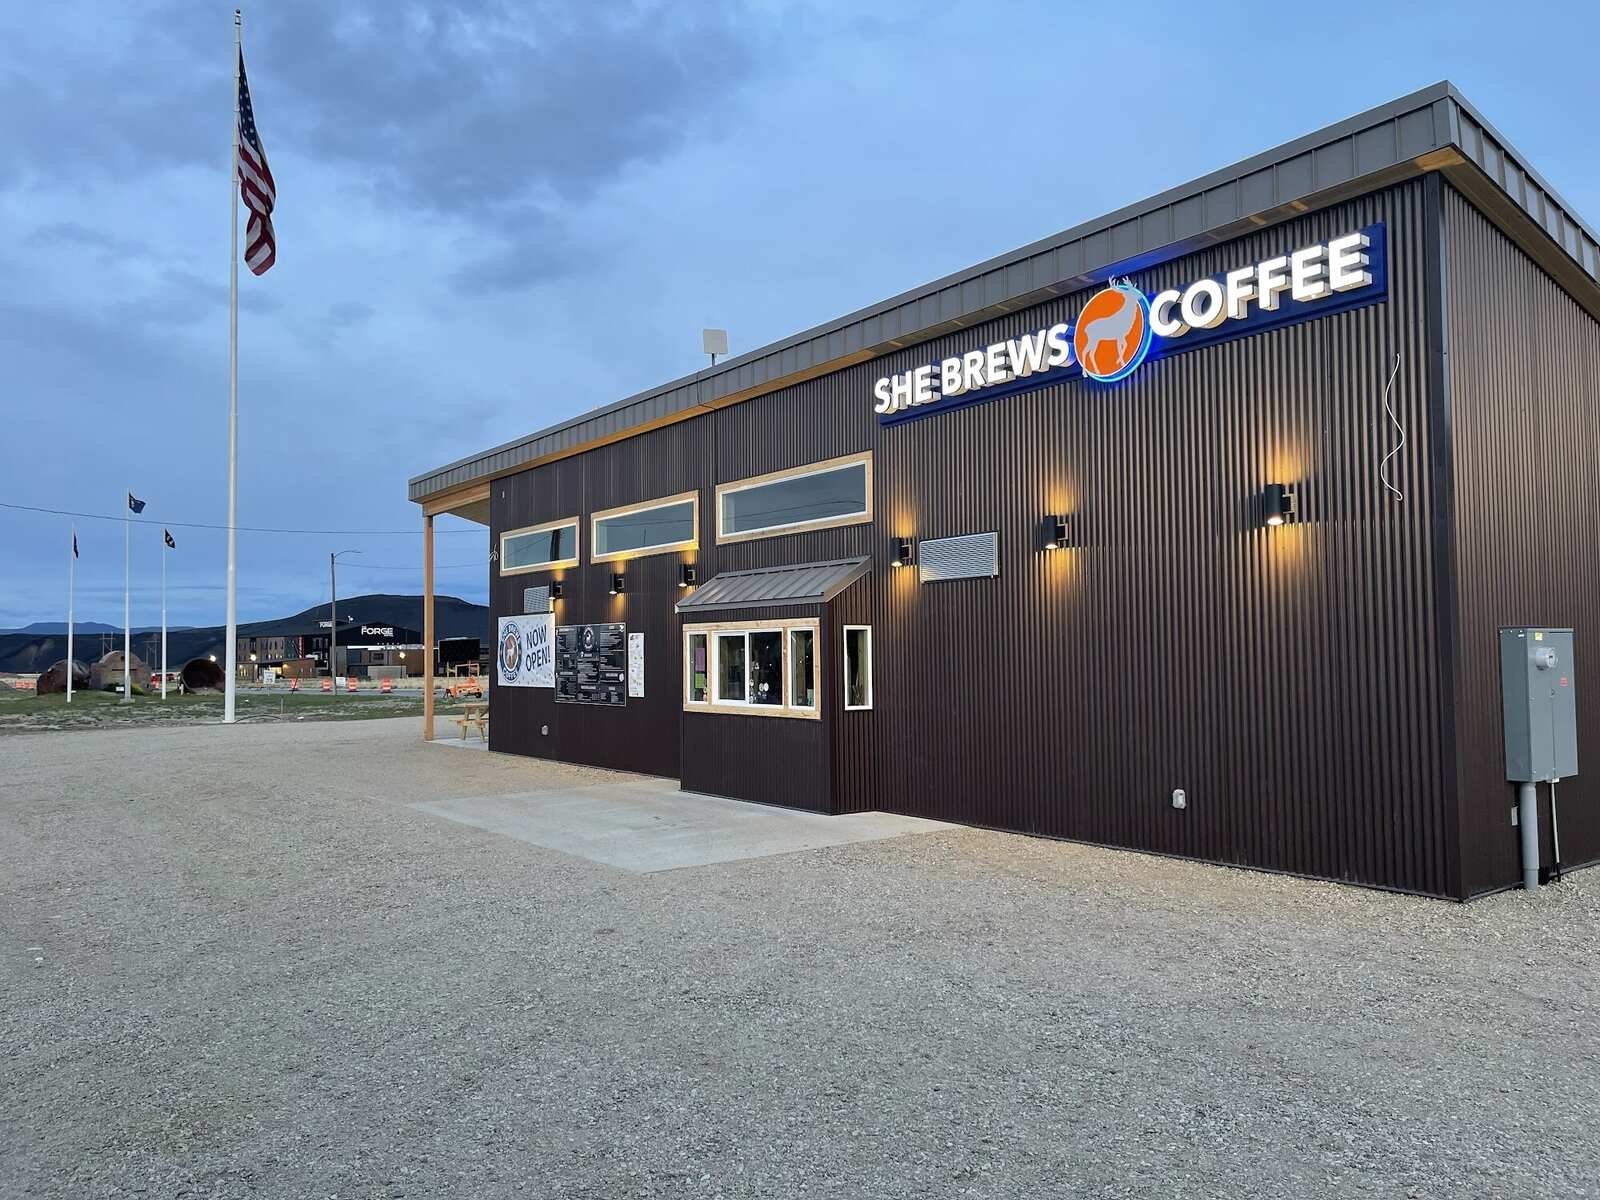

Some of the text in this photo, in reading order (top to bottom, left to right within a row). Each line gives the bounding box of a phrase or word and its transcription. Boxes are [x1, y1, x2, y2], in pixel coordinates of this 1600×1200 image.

[873, 232, 1372, 415] SHE BREWS COFFEE
[361, 627, 394, 636] FORGE
[526, 624, 547, 650] NOW
[525, 645, 551, 672] OPEN!
